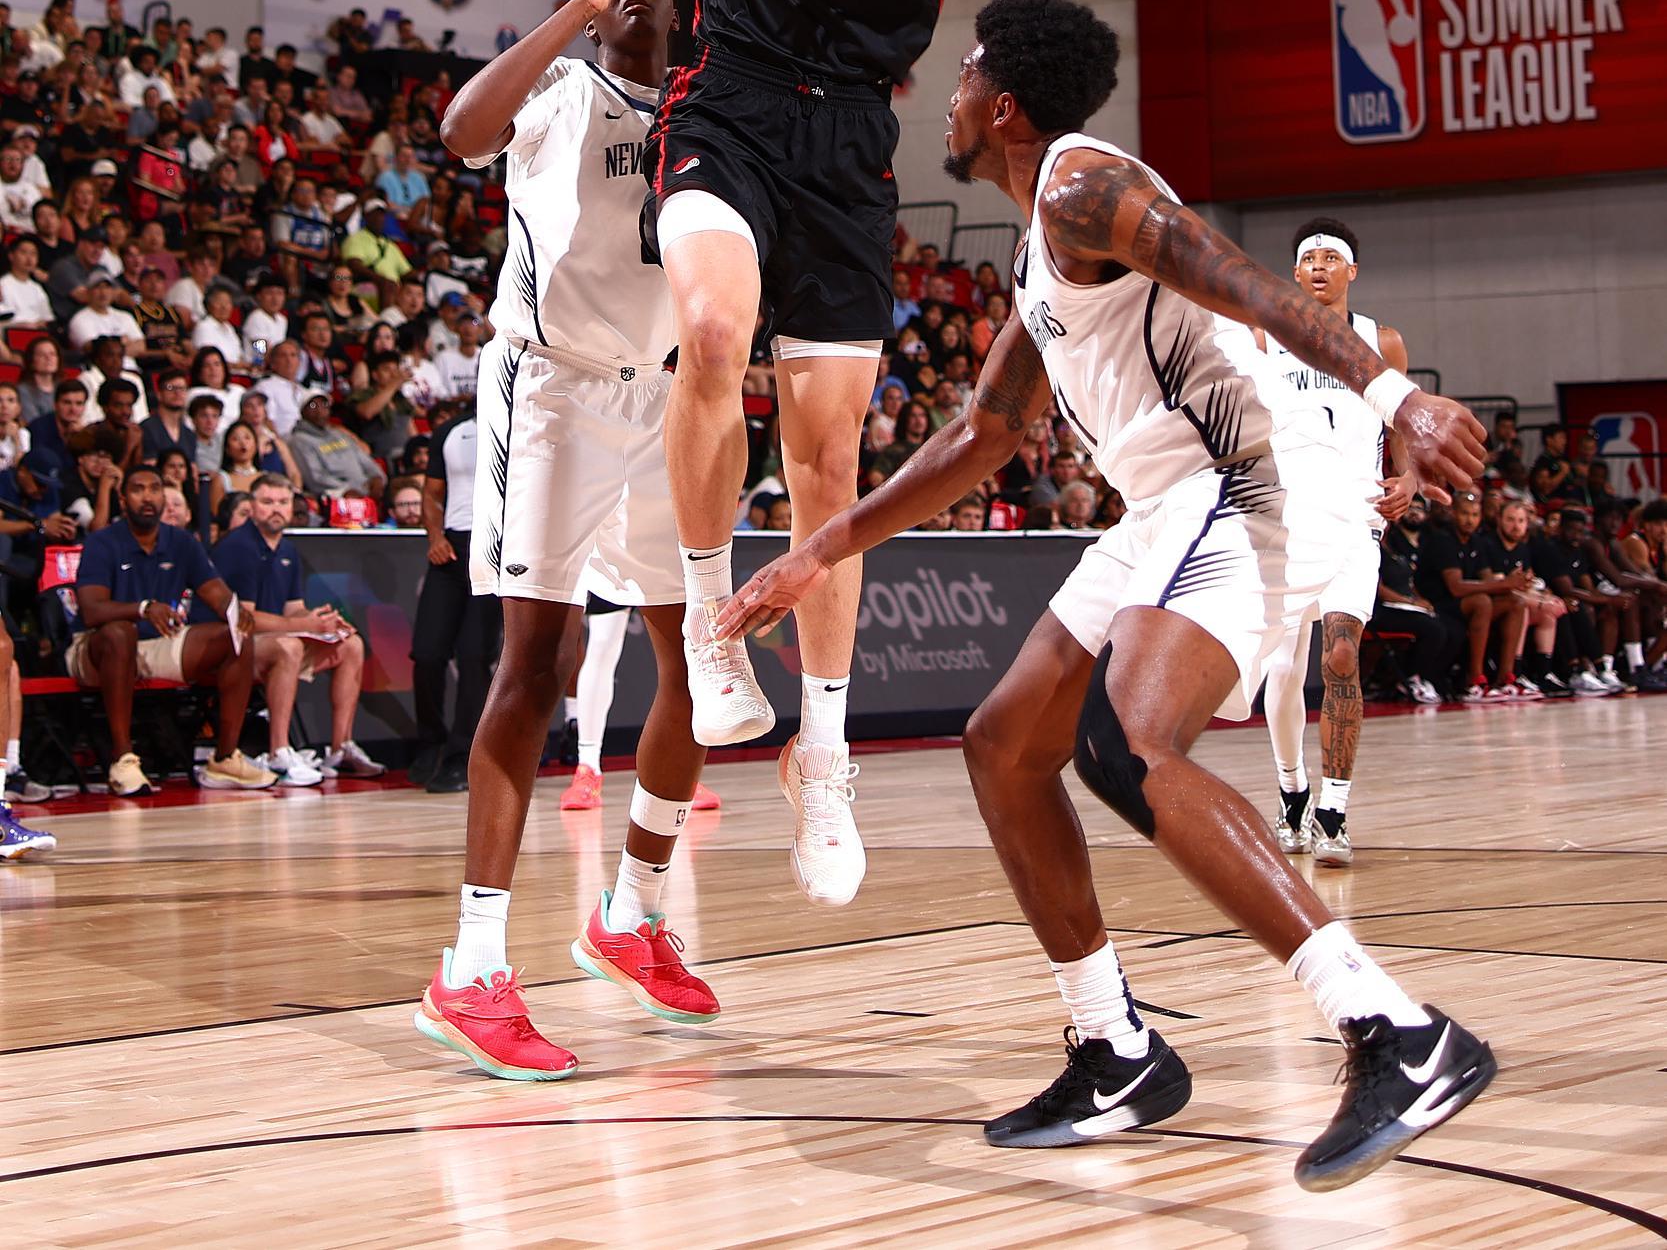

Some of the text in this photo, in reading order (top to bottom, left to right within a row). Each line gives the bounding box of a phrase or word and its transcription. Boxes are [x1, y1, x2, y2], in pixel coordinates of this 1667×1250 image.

[1440, 38, 1597, 132] LEAGUE
[1350, 92, 1391, 128] NBA
[605, 142, 644, 179] NEW
[856, 640, 991, 682] by Microsoft
